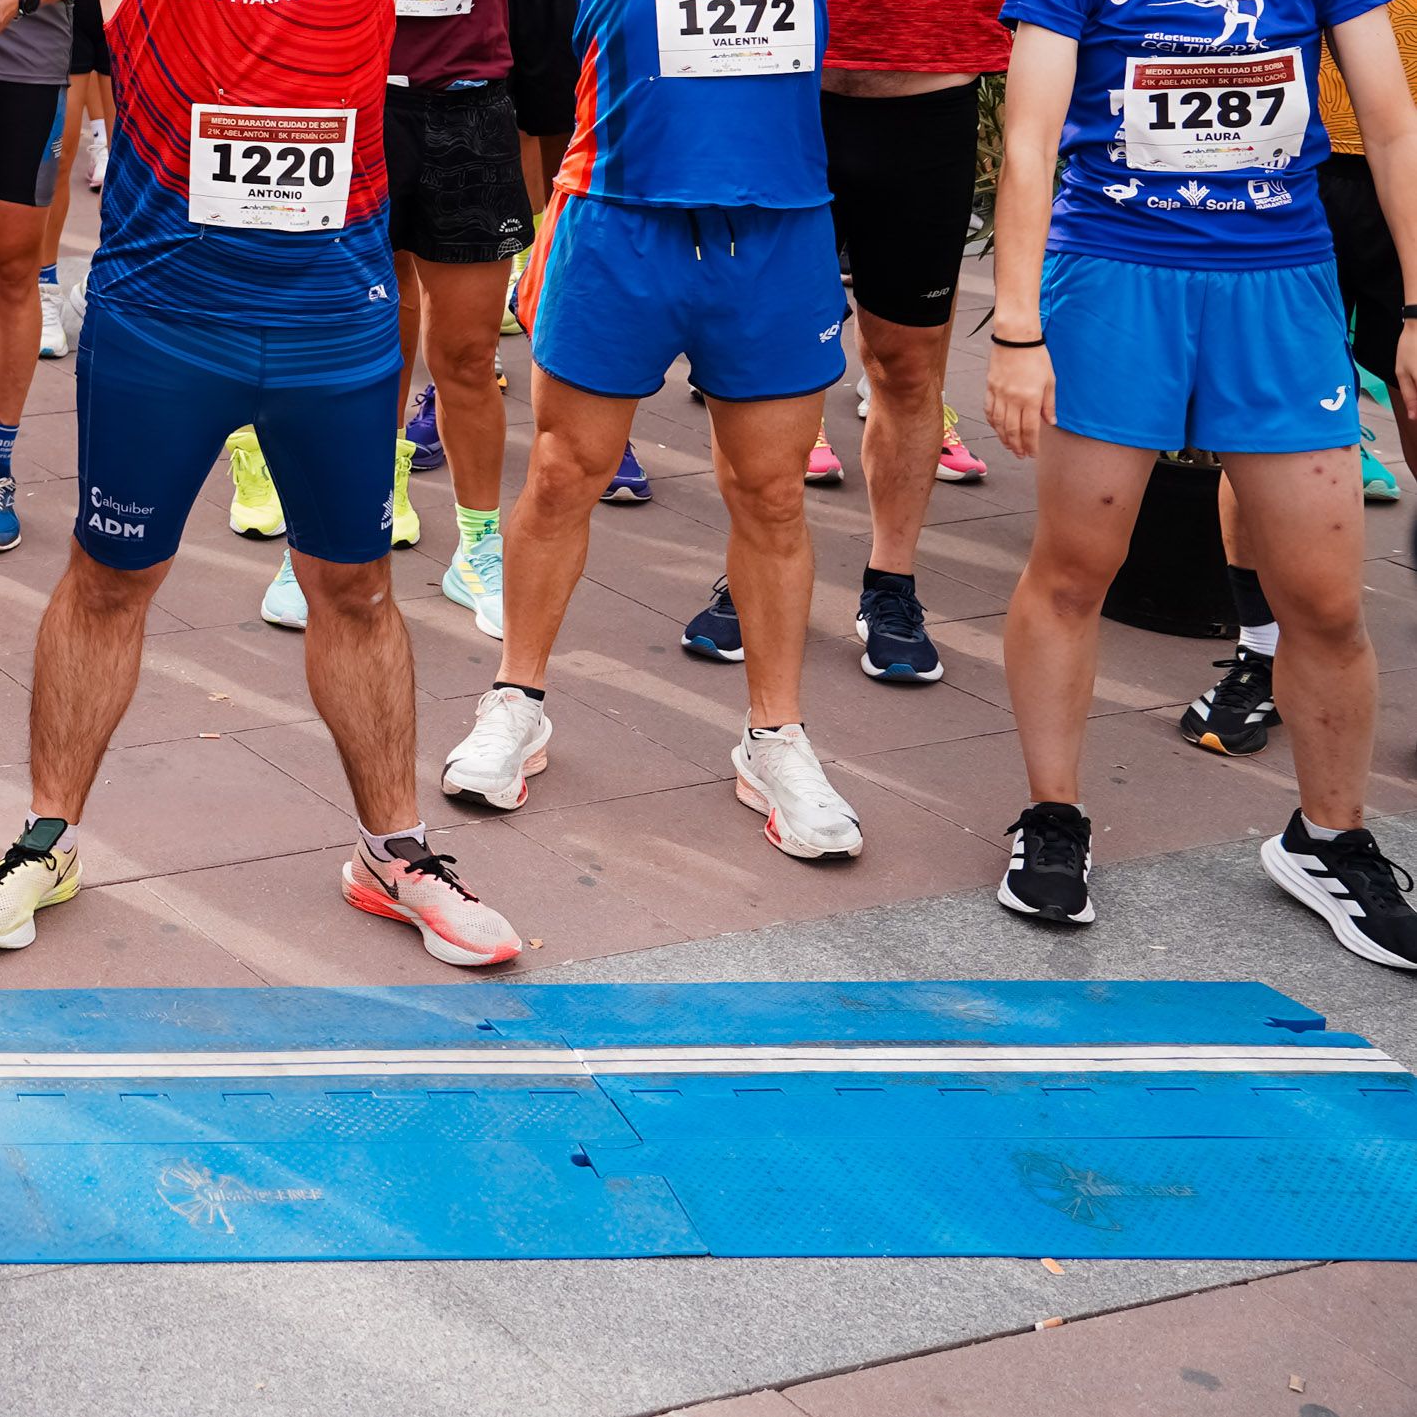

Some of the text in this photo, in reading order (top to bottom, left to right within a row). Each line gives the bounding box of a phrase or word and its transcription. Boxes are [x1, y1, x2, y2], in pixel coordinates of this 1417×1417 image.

[713, 37, 768, 46] VALENTIN
[1144, 33, 1212, 43] atletismo
[1174, 67, 1216, 75] MARATÓN
[1218, 66, 1251, 75] CIUDAD
[1179, 77, 1208, 85] ANTÓN
[1233, 76, 1264, 84] FERMÍN
[1265, 73, 1287, 81] CACHO
[1149, 87, 1285, 130] 1287
[238, 119, 276, 127] MARATÓN
[243, 130, 269, 138] ANTÓN
[291, 131, 318, 139] FERMÍN
[1196, 132, 1241, 141] LAURA
[212, 143, 334, 187] 1220
[248, 189, 302, 200] ANTONIO
[1147, 196, 1246, 211] Caja Soria
[102, 495, 155, 515] alquiber
[89, 513, 145, 538] ADM
